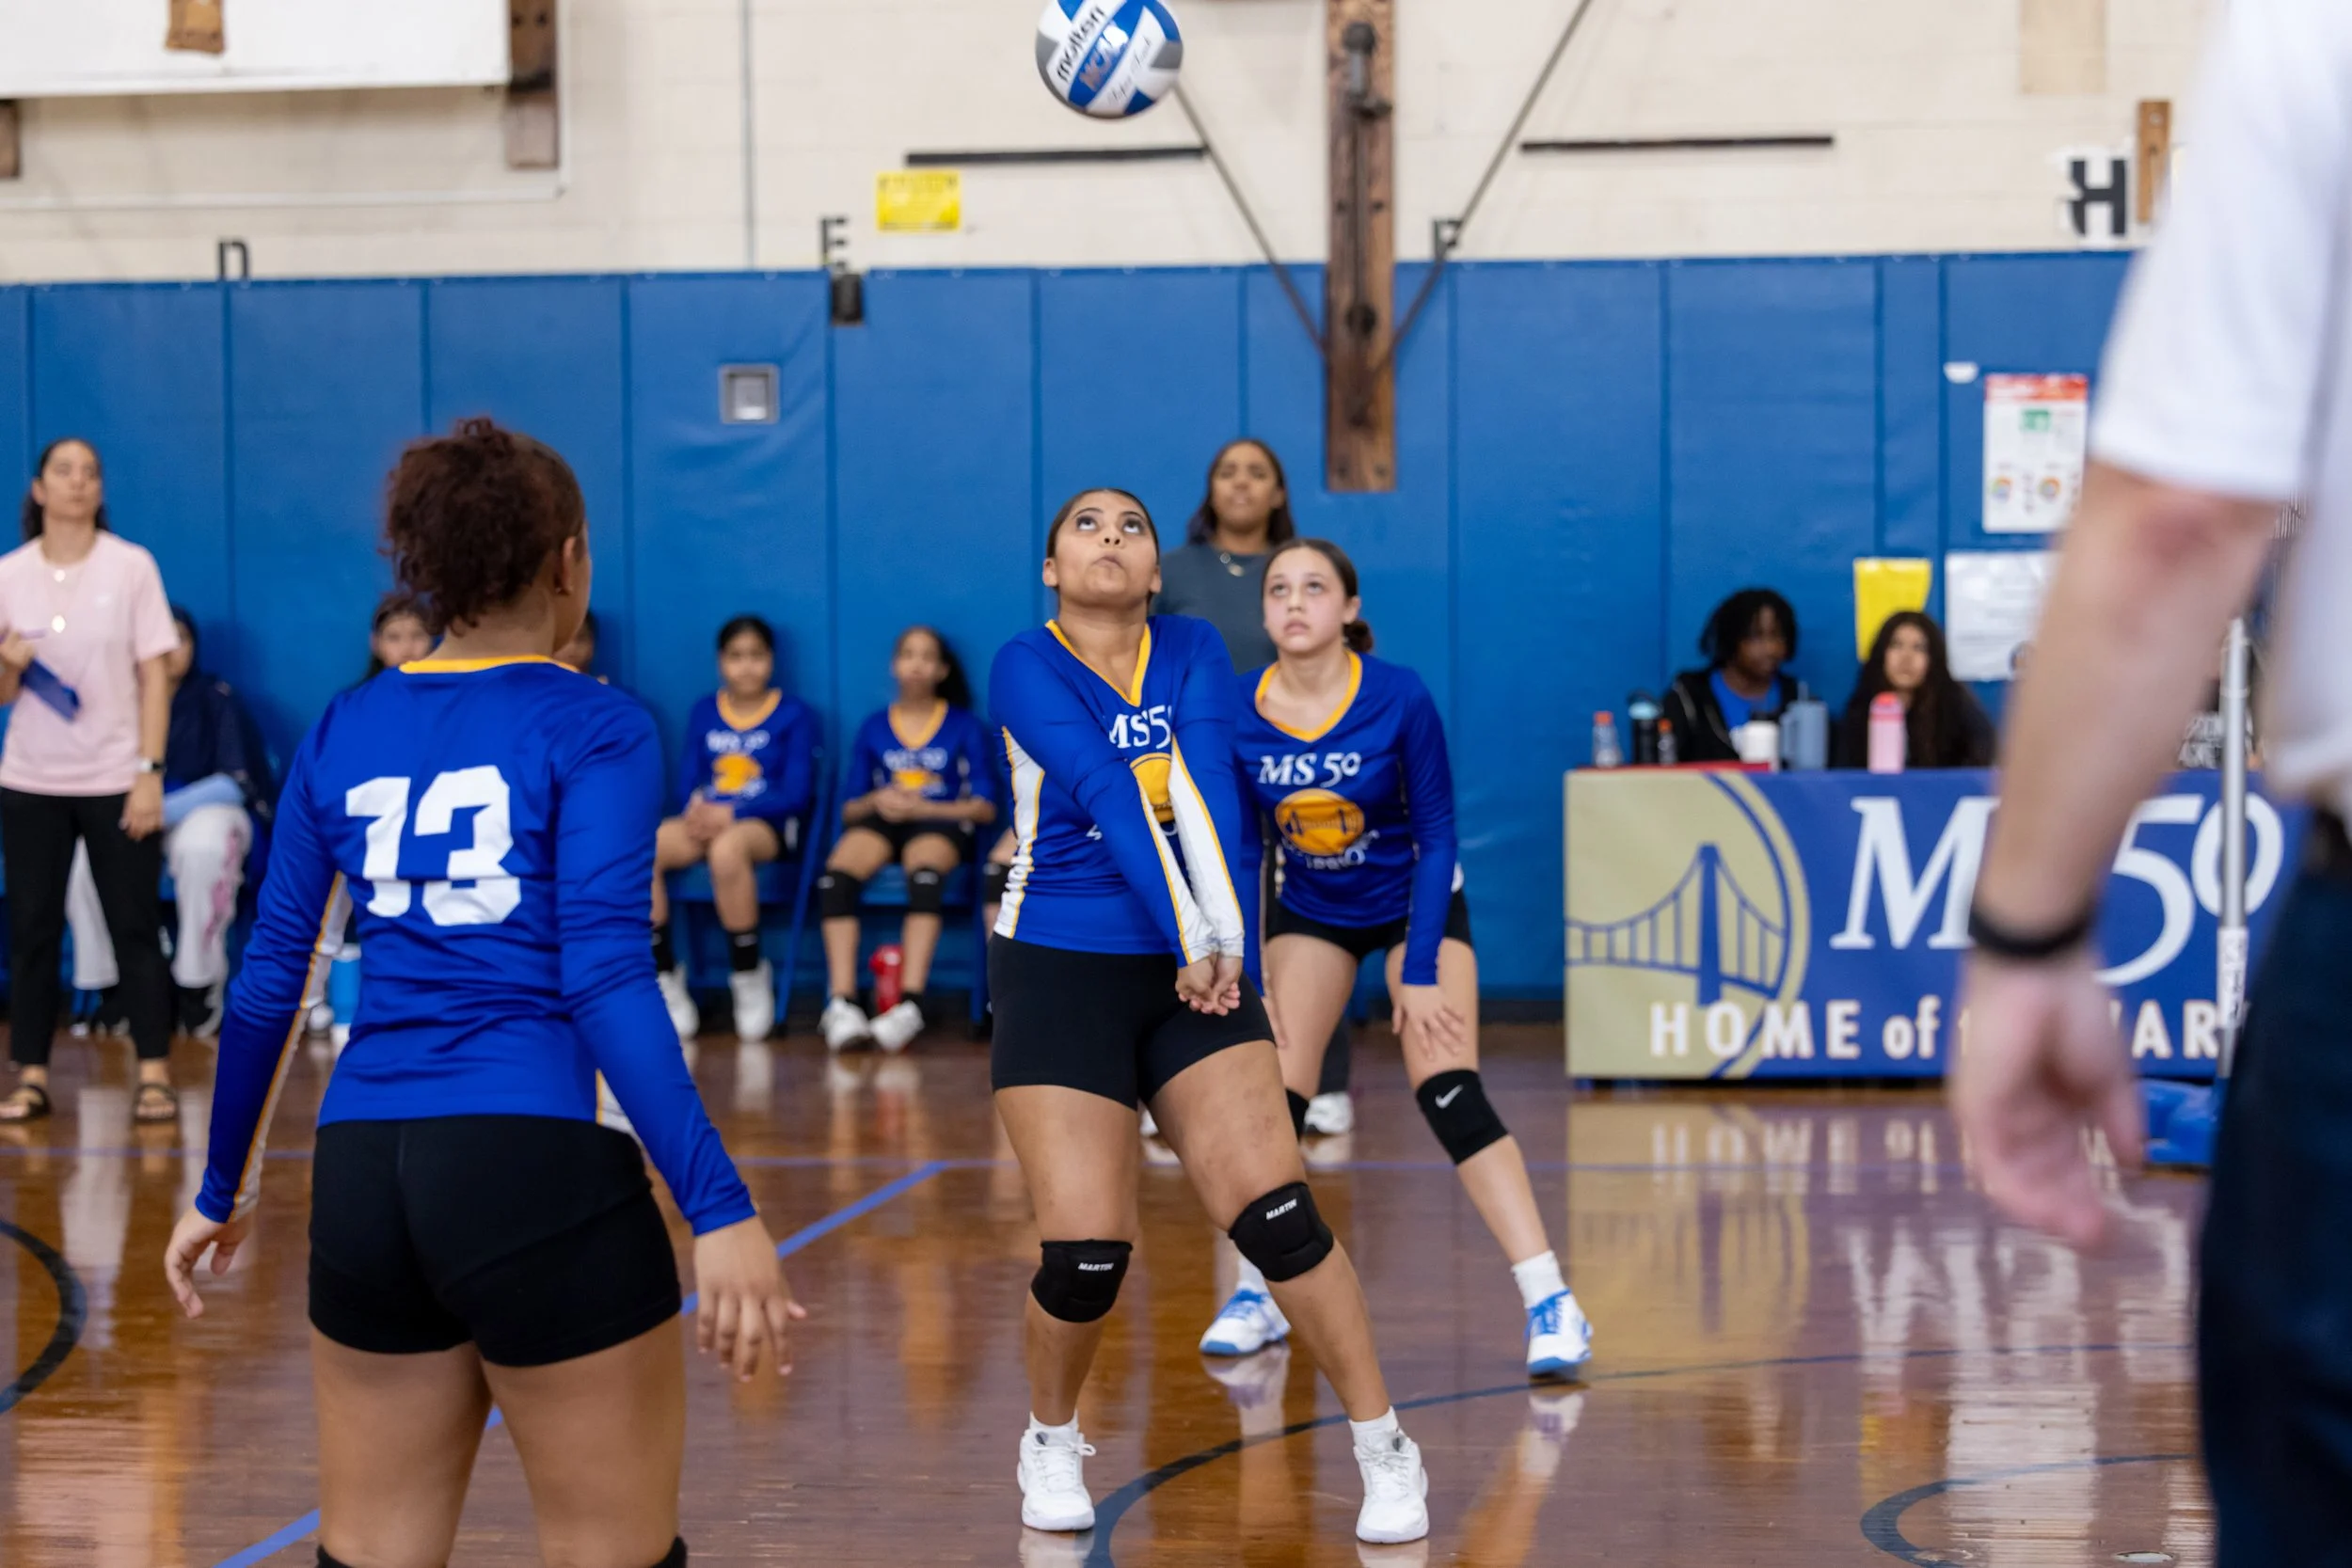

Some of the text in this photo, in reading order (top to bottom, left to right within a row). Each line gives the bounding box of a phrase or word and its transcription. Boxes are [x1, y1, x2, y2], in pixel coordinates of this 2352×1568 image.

[1056, 6, 1107, 83] molten
[2068, 157, 2127, 236] H
[1257, 751, 1362, 788] MS 50
[345, 765, 521, 927] 13
[2092, 792, 2284, 987] 50
[1649, 998, 1861, 1060] HOME
[1883, 993, 1942, 1060] of
[1265, 1197, 1297, 1221] MARTIN
